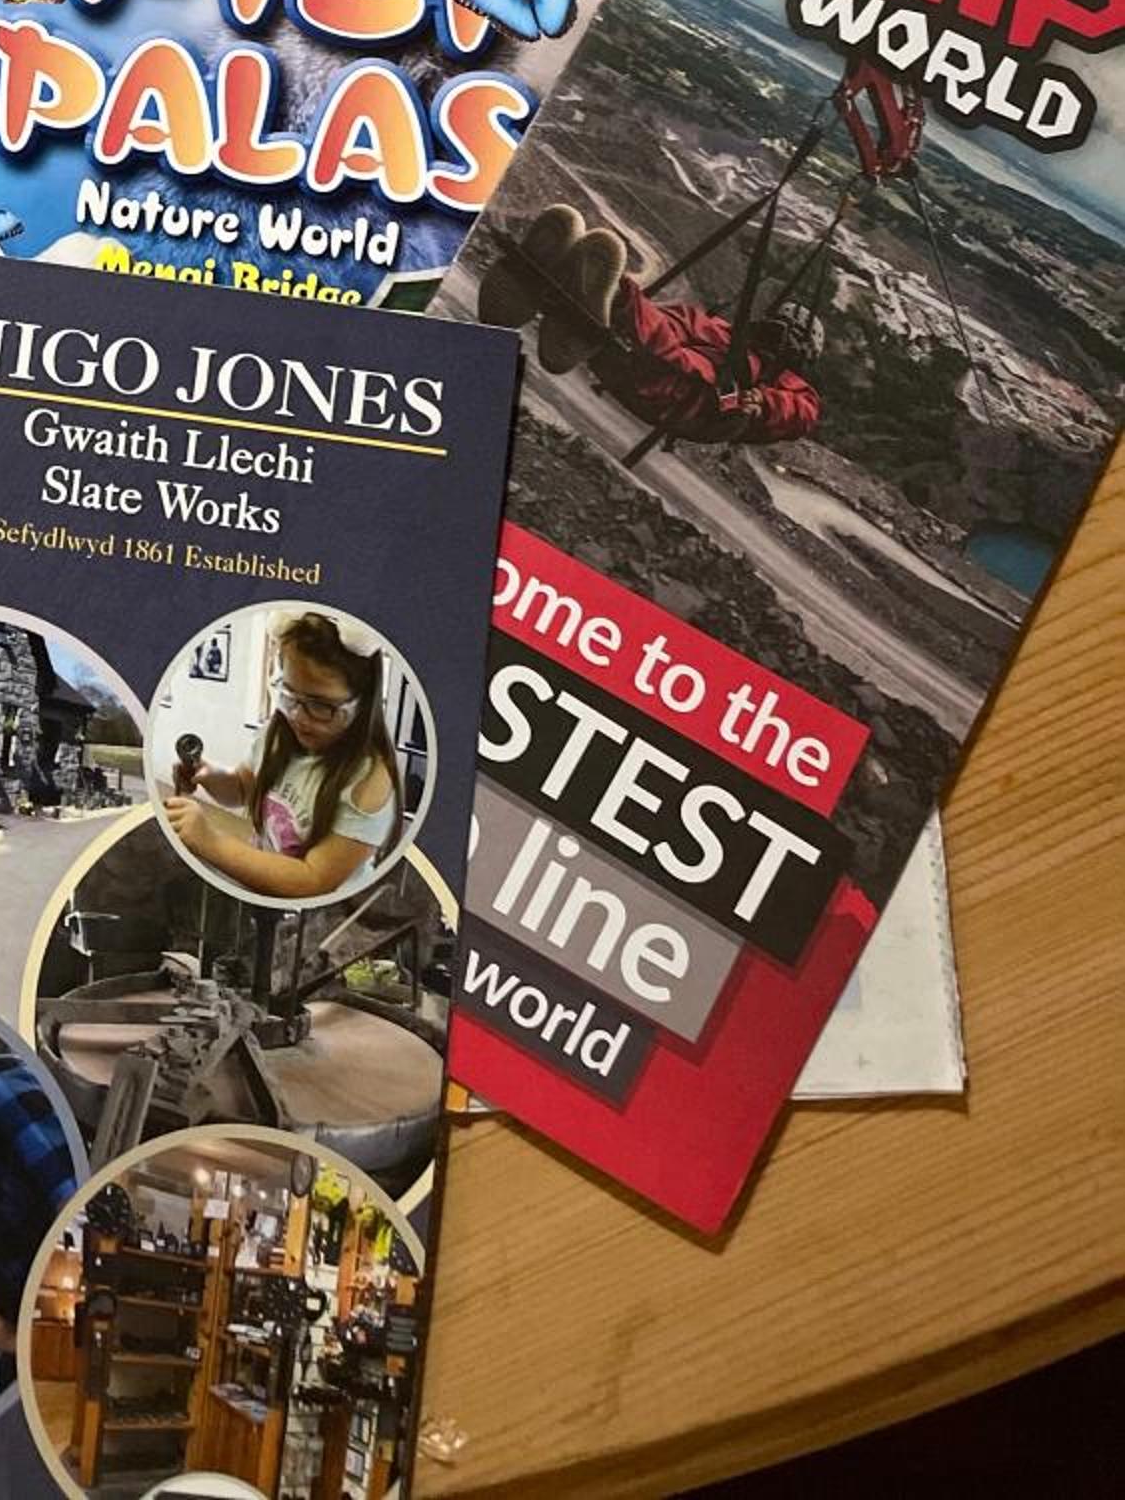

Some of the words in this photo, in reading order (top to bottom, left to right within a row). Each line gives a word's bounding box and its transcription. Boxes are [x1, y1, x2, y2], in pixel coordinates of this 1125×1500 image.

[76, 178, 240, 244] Nature
[258, 202, 401, 266] World
[175, 345, 445, 437] JONES
[22, 409, 170, 464] Gwaith
[183, 429, 315, 484] Llechi
[41, 466, 143, 515] Slate
[157, 482, 282, 535] Works
[124, 539, 176, 566] 1861
[185, 546, 322, 586] Established
[633, 633, 707, 714] to
[718, 681, 832, 789] the
[477, 663, 822, 925] STEST
[491, 817, 691, 1003] line
[462, 948, 631, 1079] world
